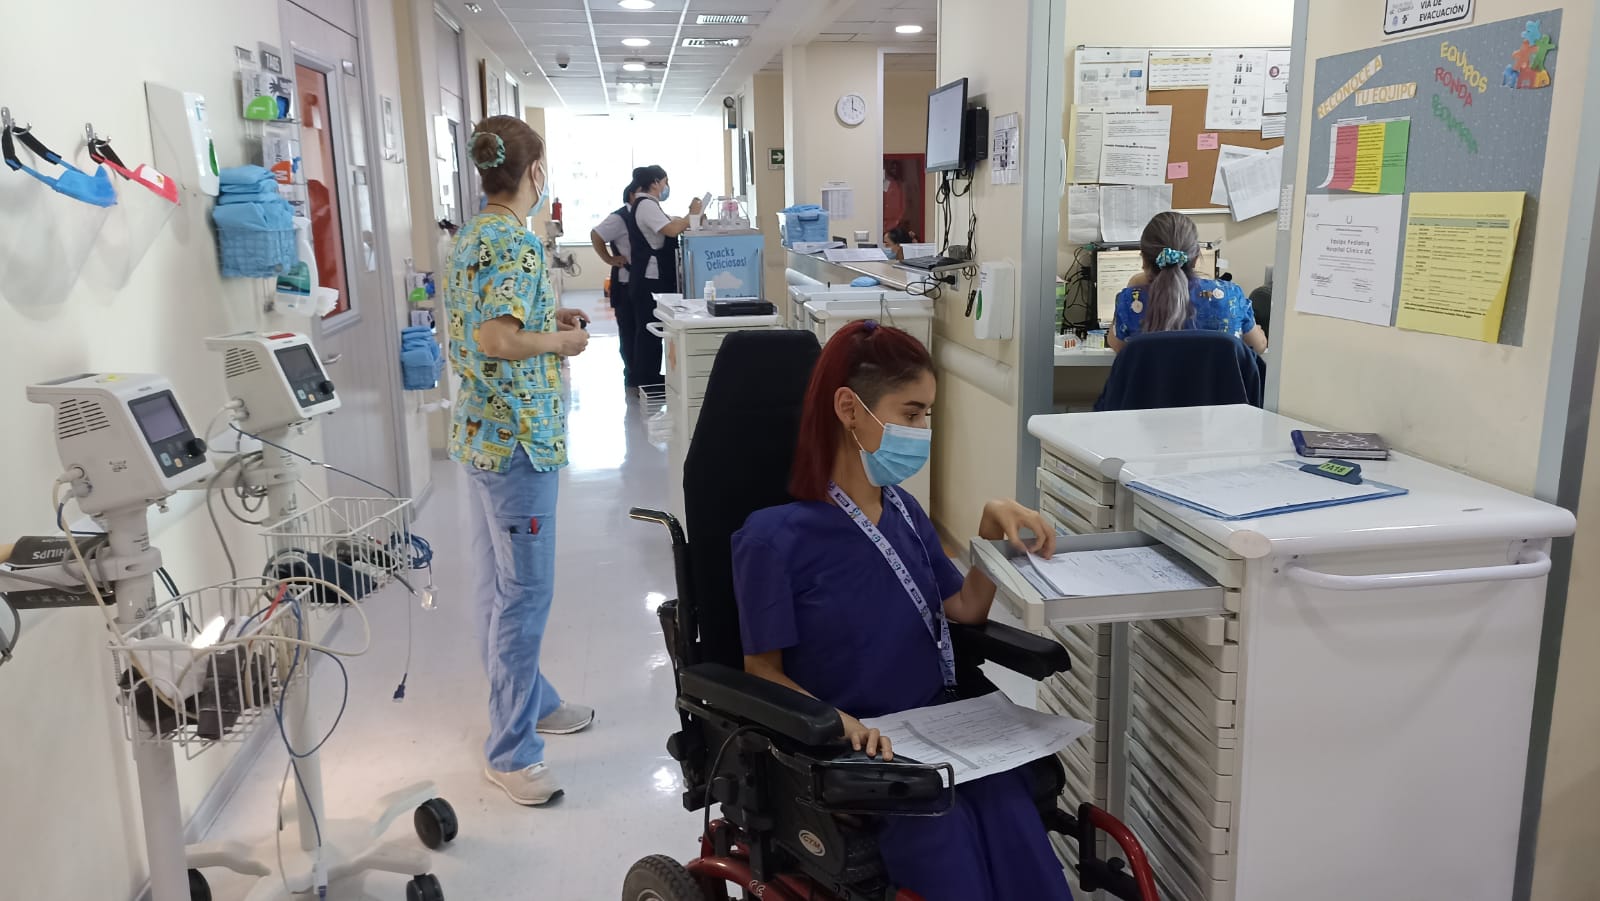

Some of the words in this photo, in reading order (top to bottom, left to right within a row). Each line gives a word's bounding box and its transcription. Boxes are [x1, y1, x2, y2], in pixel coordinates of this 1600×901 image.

[1440, 41, 1488, 93] EQUIPOS
[1317, 65, 1372, 116] RECONOCE
[1374, 56, 1383, 70] A
[1356, 90, 1370, 104] TU
[1434, 66, 1473, 108] RONDA
[704, 247, 735, 260] Snacks
[31, 547, 71, 560] HILIPS
